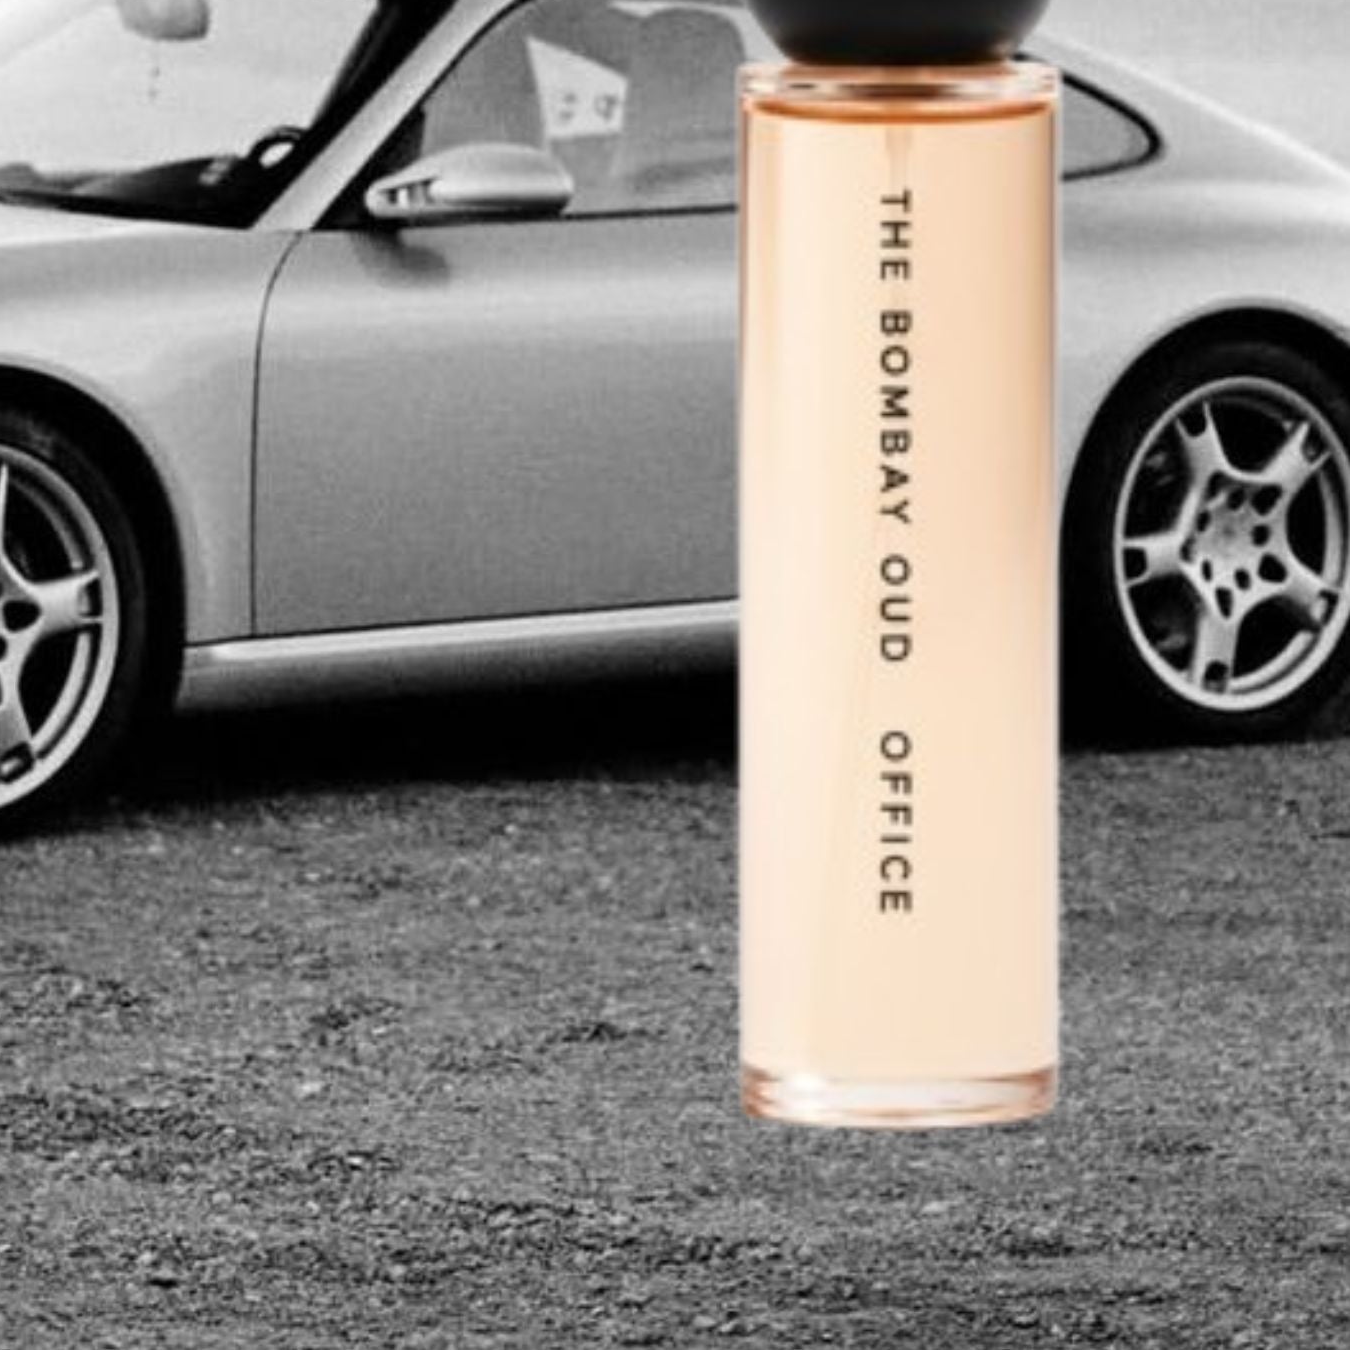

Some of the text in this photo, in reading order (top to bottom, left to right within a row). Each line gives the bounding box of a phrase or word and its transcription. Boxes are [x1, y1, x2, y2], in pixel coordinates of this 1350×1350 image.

[878, 189, 914, 913] THE BOMBAY OUD OFFICE
